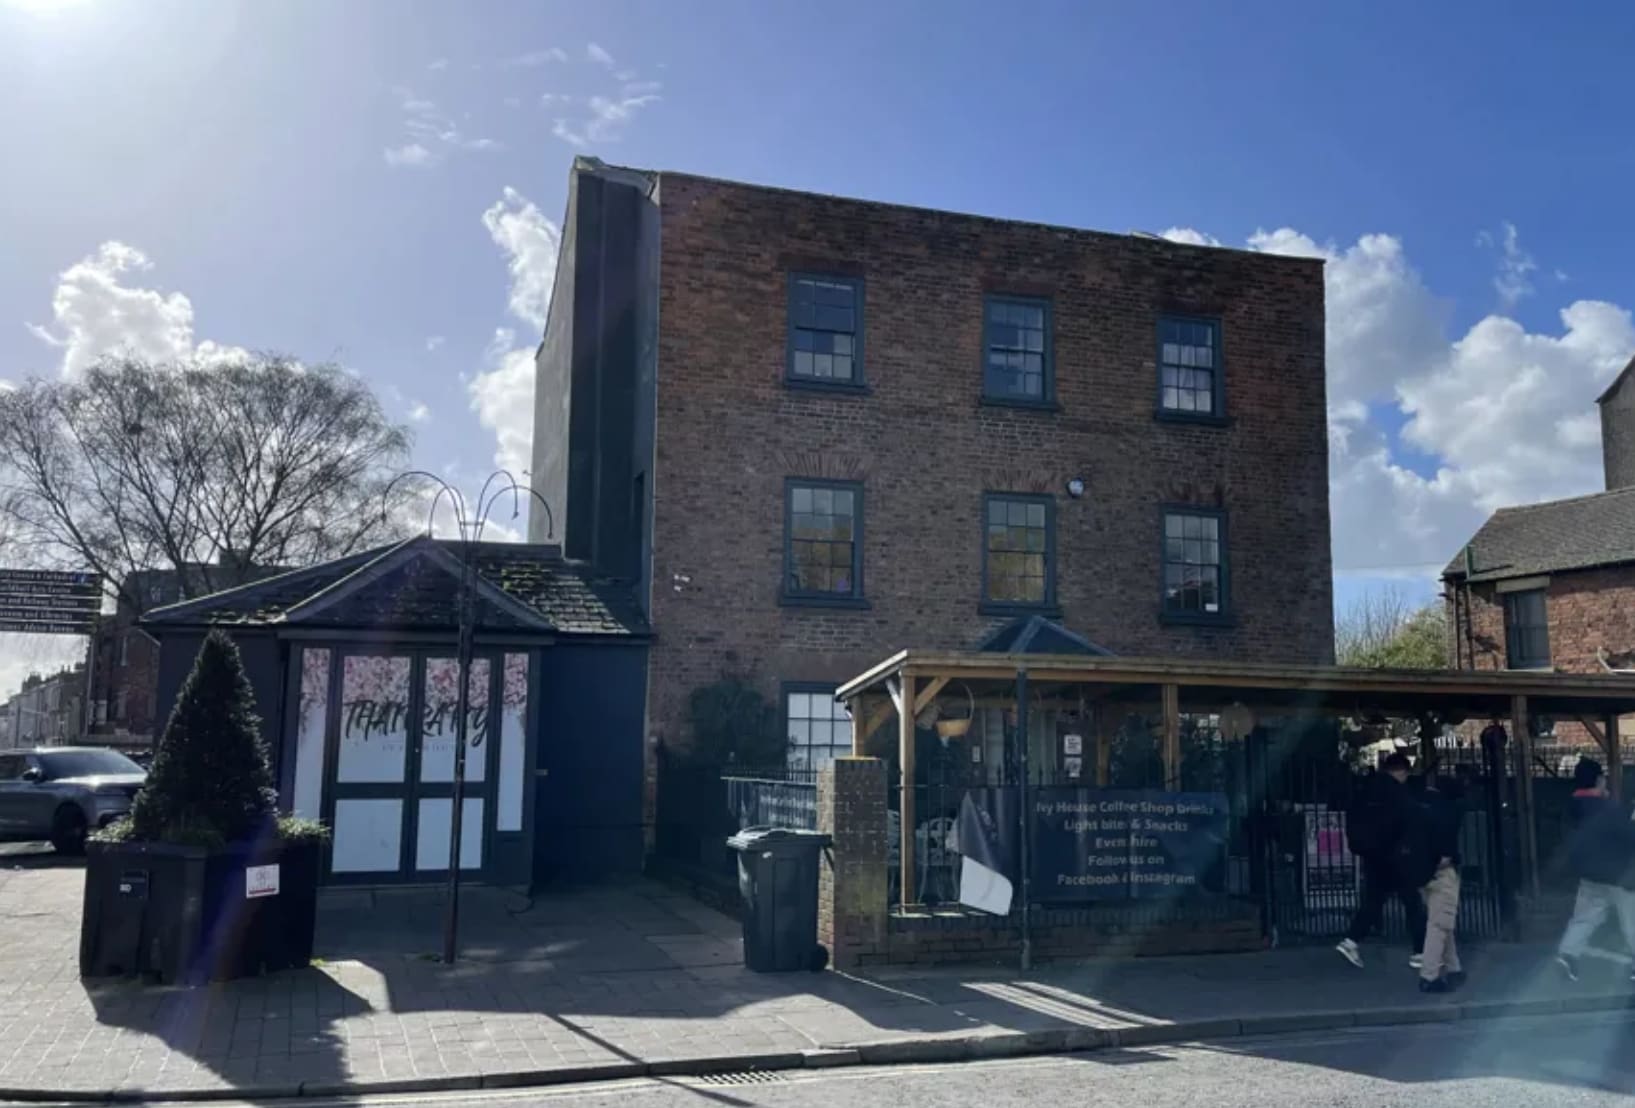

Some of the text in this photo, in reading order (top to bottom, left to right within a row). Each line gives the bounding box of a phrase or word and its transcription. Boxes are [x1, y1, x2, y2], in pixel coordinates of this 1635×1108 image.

[1056, 801, 1097, 813] House
[1099, 801, 1139, 813] Coffee
[1140, 801, 1175, 816] Shop
[1064, 819, 1098, 833] Light
[1130, 819, 1141, 830] &
[1143, 819, 1189, 832] Snacks
[1130, 833, 1159, 848] hire
[1088, 854, 1165, 867] Follow us on
[1057, 873, 1119, 886] Facebook
[1130, 871, 1196, 885] Instagram
